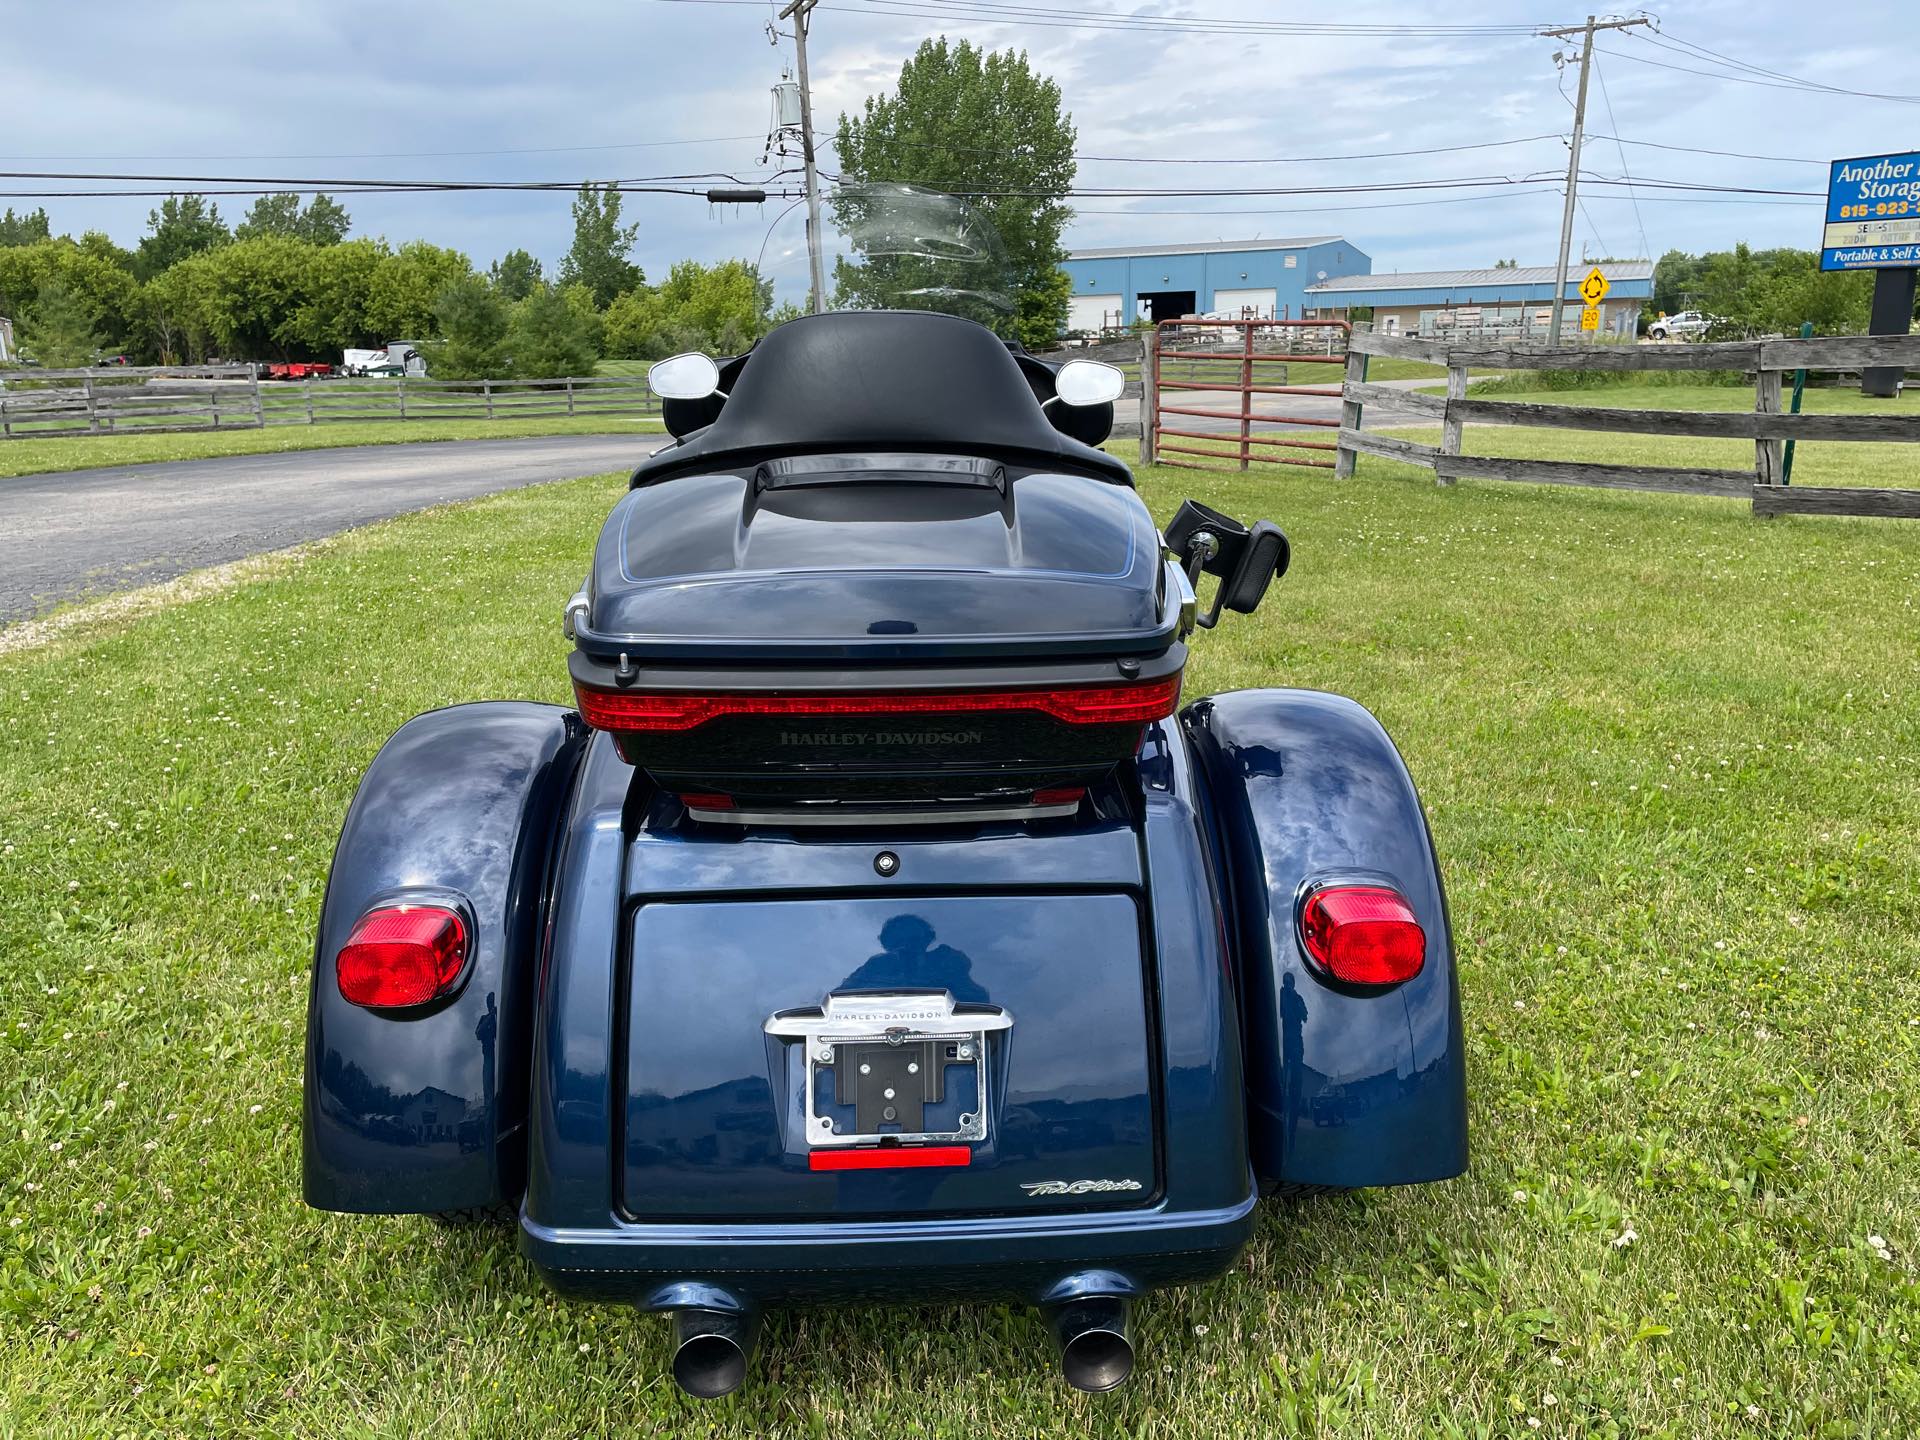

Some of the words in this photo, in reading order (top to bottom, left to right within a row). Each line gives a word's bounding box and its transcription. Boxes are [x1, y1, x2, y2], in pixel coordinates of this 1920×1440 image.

[1837, 160, 1913, 183] Another
[1834, 250, 1877, 262] Portable
[1880, 249, 1889, 260] &
[1891, 246, 1914, 260] Self
[1585, 312, 1597, 322] 20
[780, 731, 983, 745] HARLEY-DAVIDSON
[834, 1012, 942, 1020] HARLEY-DAVIDSON
